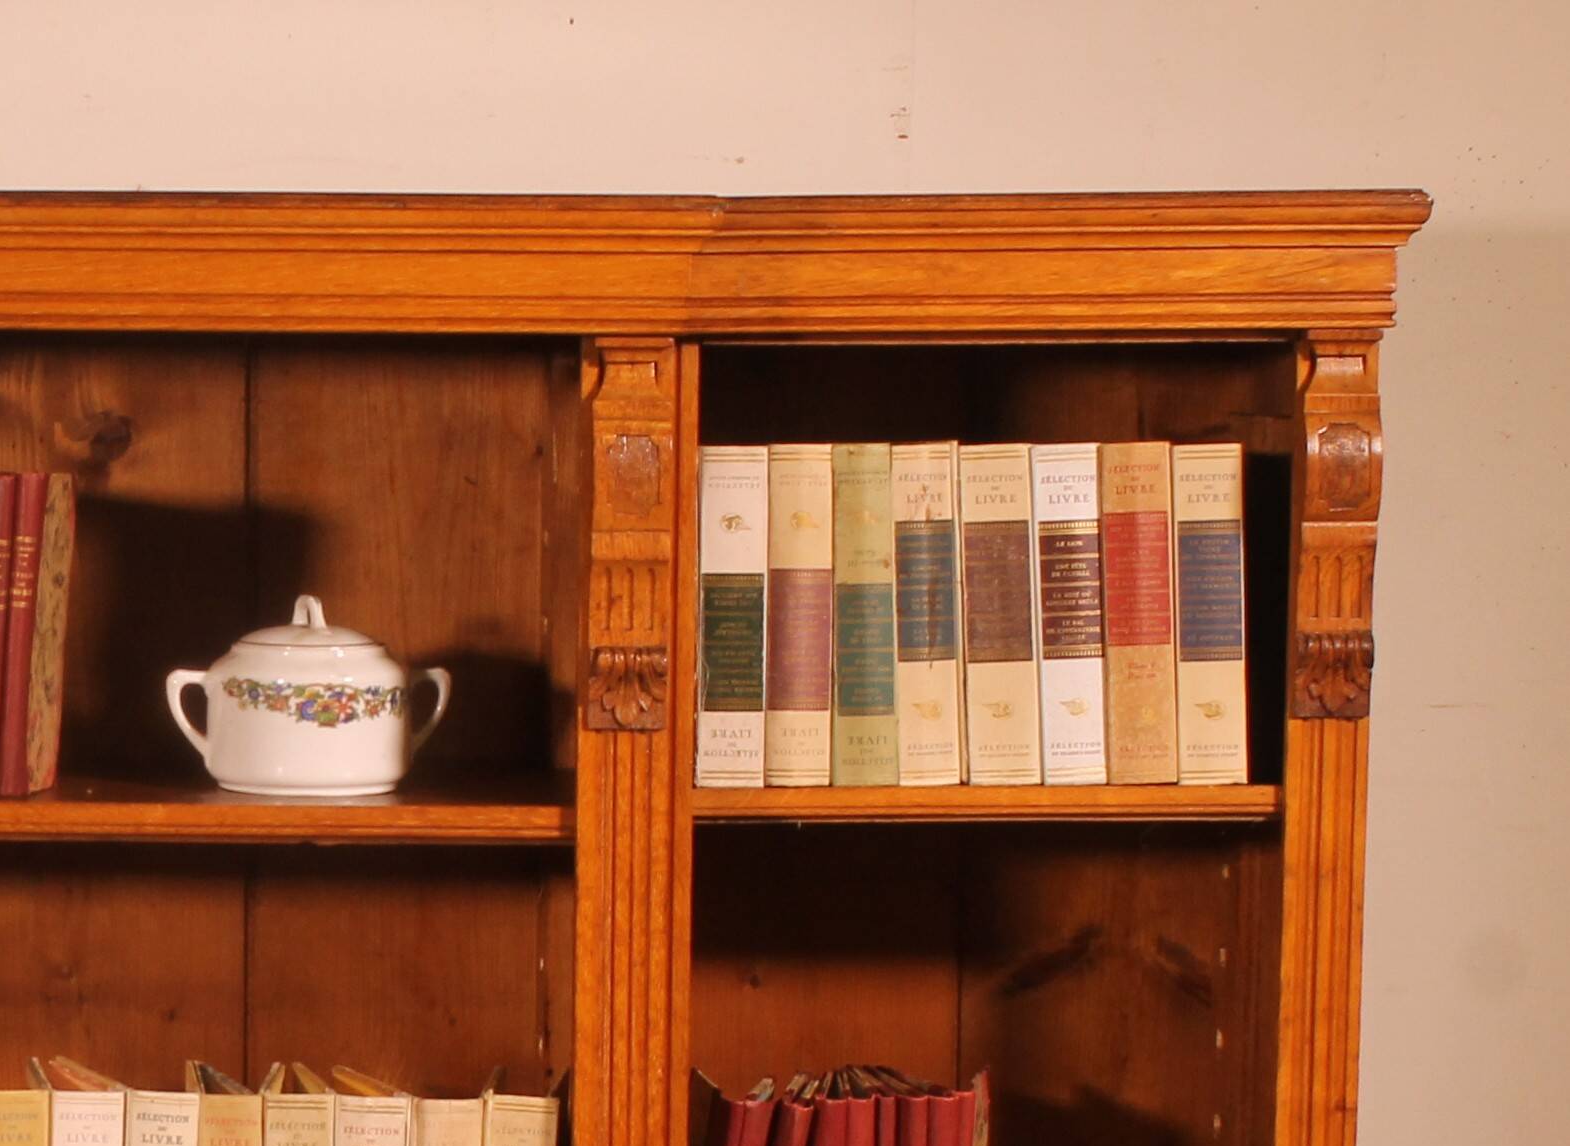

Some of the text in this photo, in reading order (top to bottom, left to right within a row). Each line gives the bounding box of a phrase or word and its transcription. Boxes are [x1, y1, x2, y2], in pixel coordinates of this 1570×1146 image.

[1115, 484, 1156, 496] LIVRE
[974, 494, 1017, 506] LIVRE
[1047, 493, 1091, 505] LIVRE
[1187, 492, 1230, 504] LIVRE
[710, 729, 753, 740] LIVRE
[136, 1111, 190, 1124] SÉLECTION
[66, 1132, 110, 1144] LIVRE
[141, 1133, 184, 1146] LIVRE
